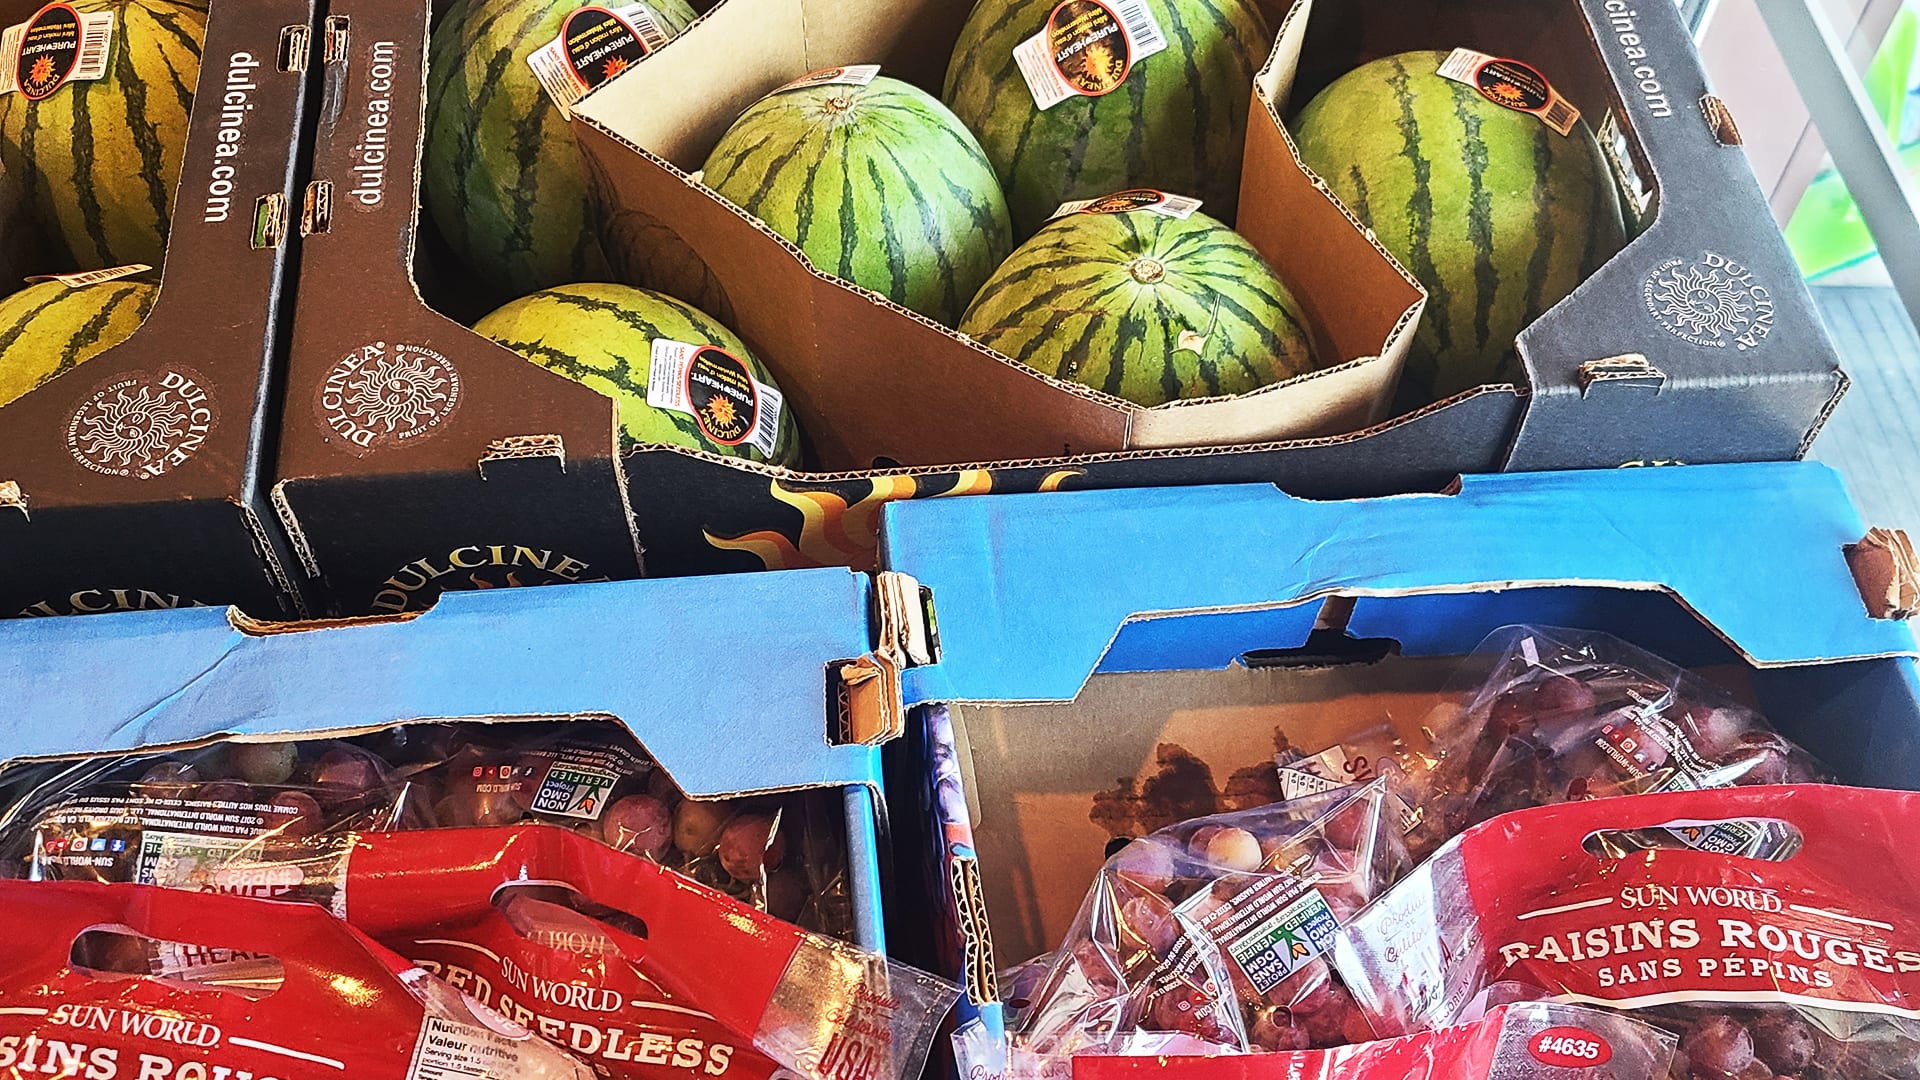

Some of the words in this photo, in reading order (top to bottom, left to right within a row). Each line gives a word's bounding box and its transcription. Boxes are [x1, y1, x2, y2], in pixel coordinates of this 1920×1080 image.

[24, 74, 60, 96] DULCINEA
[1079, 60, 1123, 91] DULINEA
[351, 40, 396, 205] dulcinea.com
[204, 50, 260, 224] dulcinea.com
[1702, 251, 1774, 348] DULCINEA
[108, 379, 137, 392] FRUIT
[323, 344, 386, 447] DULCINEA
[159, 372, 211, 476] DULCINEA
[398, 424, 428, 439] FRUIT
[700, 408, 741, 439] DULCINEA
[70, 447, 119, 475] PERFECTION
[371, 545, 610, 613] DULCINE
[546, 780, 574, 793] Project
[551, 771, 609, 786] VERIFIED
[538, 798, 566, 810] NON
[542, 788, 570, 801] GMO
[1708, 836, 1734, 852] GMO
[1717, 822, 1749, 841] VERIFI
[1620, 886, 1679, 910] SUN
[1684, 885, 1781, 912] WORLD
[1282, 899, 1325, 932] VERIFIED
[1302, 909, 1330, 932] Project
[1307, 917, 1336, 941] GMO
[1499, 918, 1700, 968] RAISINS
[1717, 919, 1920, 975] ROUGES
[1244, 948, 1276, 974] OGM
[1250, 957, 1283, 983] SANS
[1599, 958, 1681, 988] SANS
[1698, 953, 1833, 988] PÉPINS
[501, 957, 528, 993] SUN
[532, 976, 622, 1012] WORLD
[1257, 965, 1288, 990] PROJET
[52, 1003, 113, 1034] SUN
[121, 1012, 220, 1048] WORLD
[500, 993, 734, 1076] SEEDLESS
[424, 1047, 452, 1060] Serving
[470, 1056, 481, 1064] 1.5
[429, 1035, 467, 1051] Valeur
[1538, 1037, 1600, 1059] #4635
